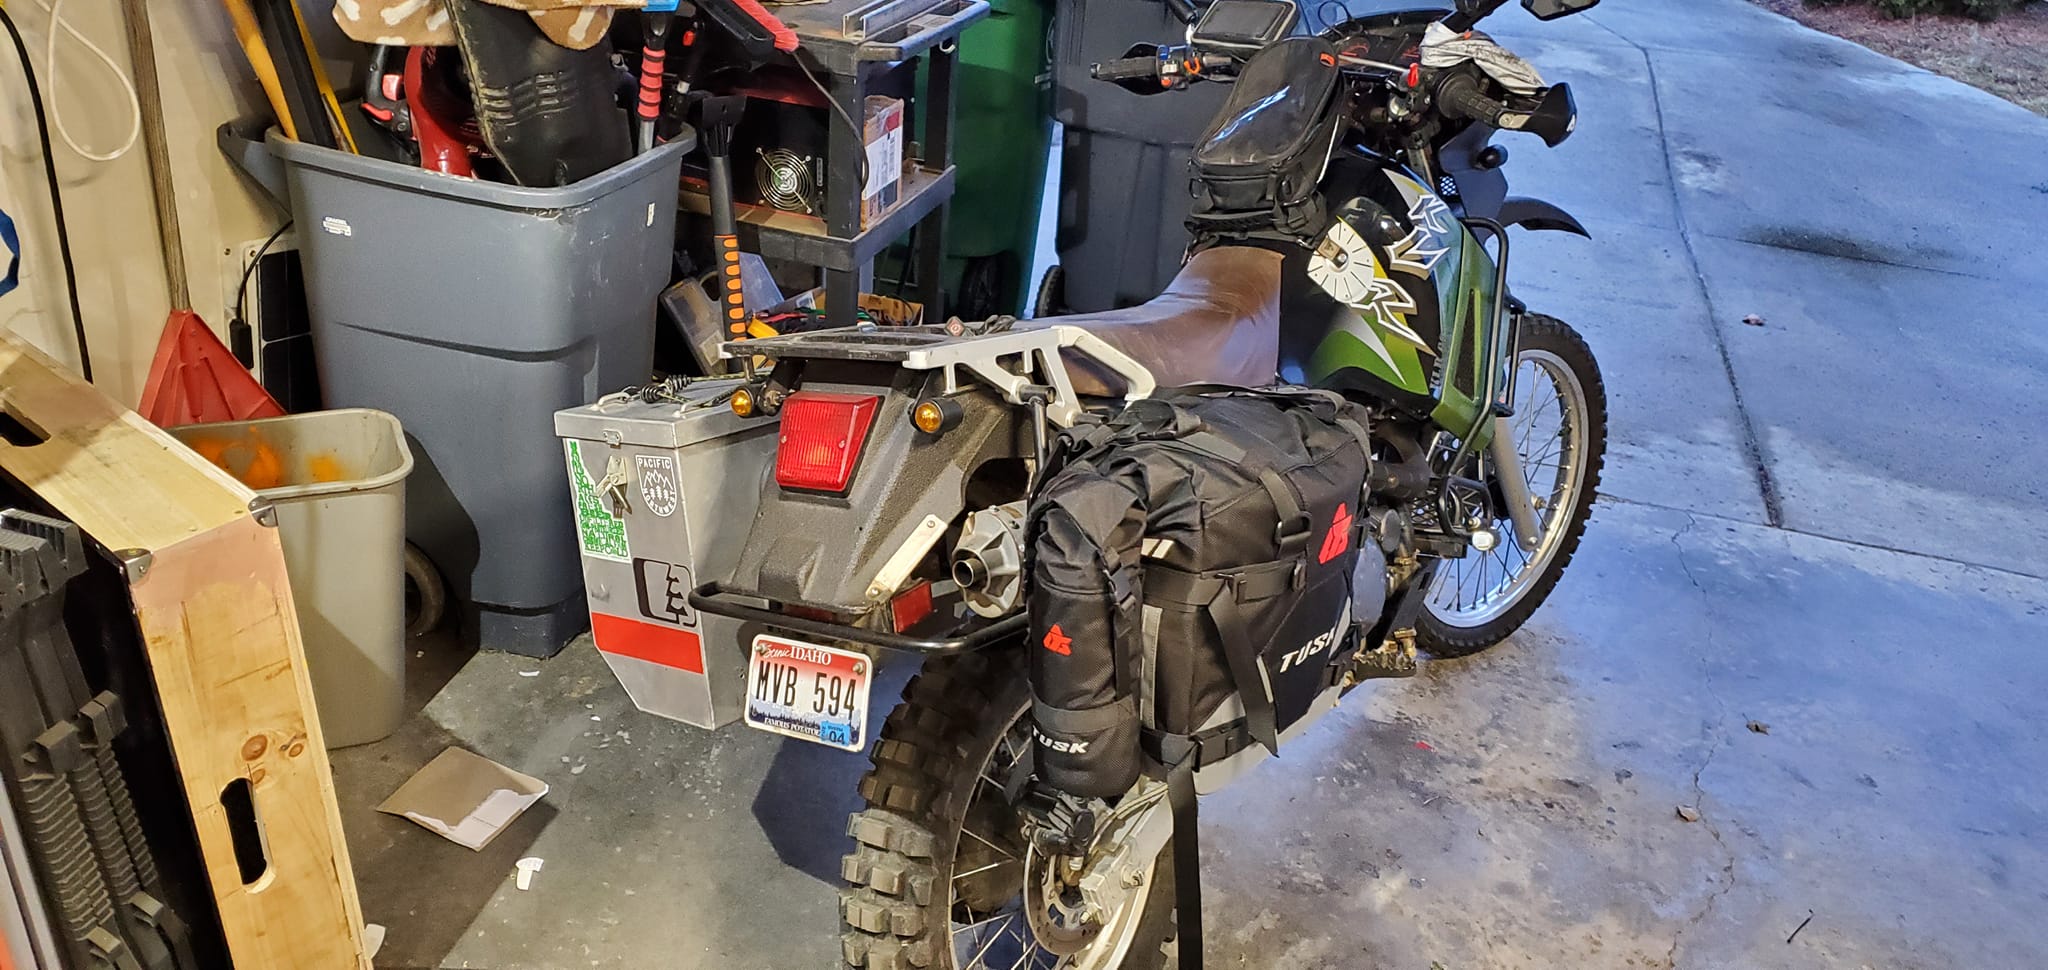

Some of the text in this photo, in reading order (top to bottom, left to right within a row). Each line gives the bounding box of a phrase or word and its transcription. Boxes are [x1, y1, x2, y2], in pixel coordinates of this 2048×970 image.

[638, 457, 671, 470] PACIFIC
[642, 486, 675, 514] NORTHWEST
[790, 647, 831, 665] IDAHO
[756, 660, 857, 719] MVB 594
[764, 718, 791, 730] FAMOUS
[790, 723, 820, 736] POTATOE
[829, 730, 846, 745] 04
[1032, 725, 1089, 754] TUSK
